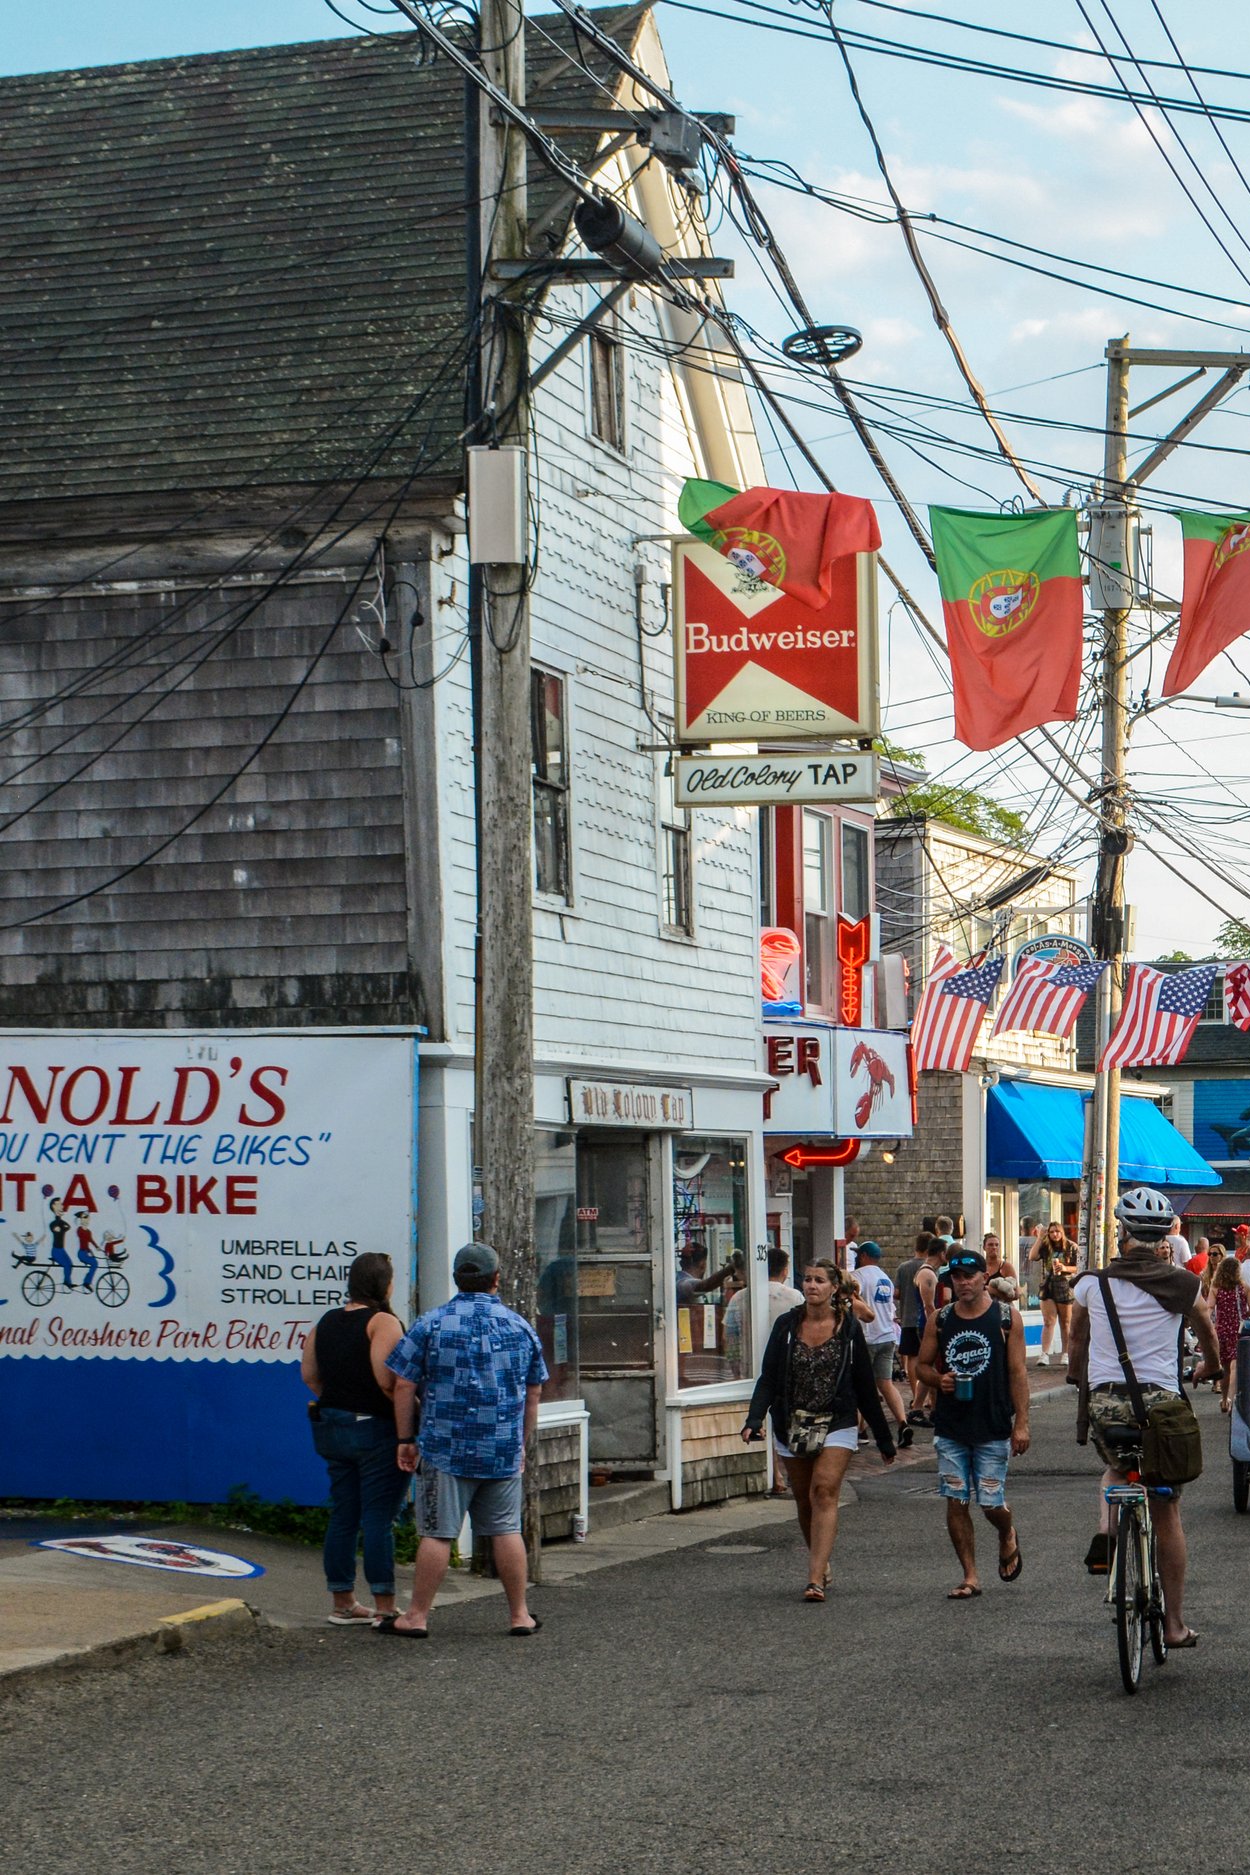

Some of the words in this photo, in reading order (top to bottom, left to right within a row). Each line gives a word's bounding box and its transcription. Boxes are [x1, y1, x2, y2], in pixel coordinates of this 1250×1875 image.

[685, 623, 856, 653] Budweiser
[706, 712, 746, 725] KING
[749, 710, 772, 723] OF
[686, 767, 731, 794] Old
[731, 764, 803, 793] Colony
[808, 763, 858, 786] TAP
[763, 1036, 823, 1088] ER
[0, 1056, 289, 1128] NOLD'S
[37, 1133, 126, 1164] RENT
[139, 1133, 203, 1165] THE
[136, 1174, 258, 1215] BIKE
[221, 1239, 358, 1257] UMBRELLAS
[222, 1264, 283, 1280] SAND
[43, 1316, 152, 1348] Seashore
[156, 1319, 221, 1349] Park
[225, 1319, 282, 1350] Bike
[945, 1345, 992, 1365] Legacy
